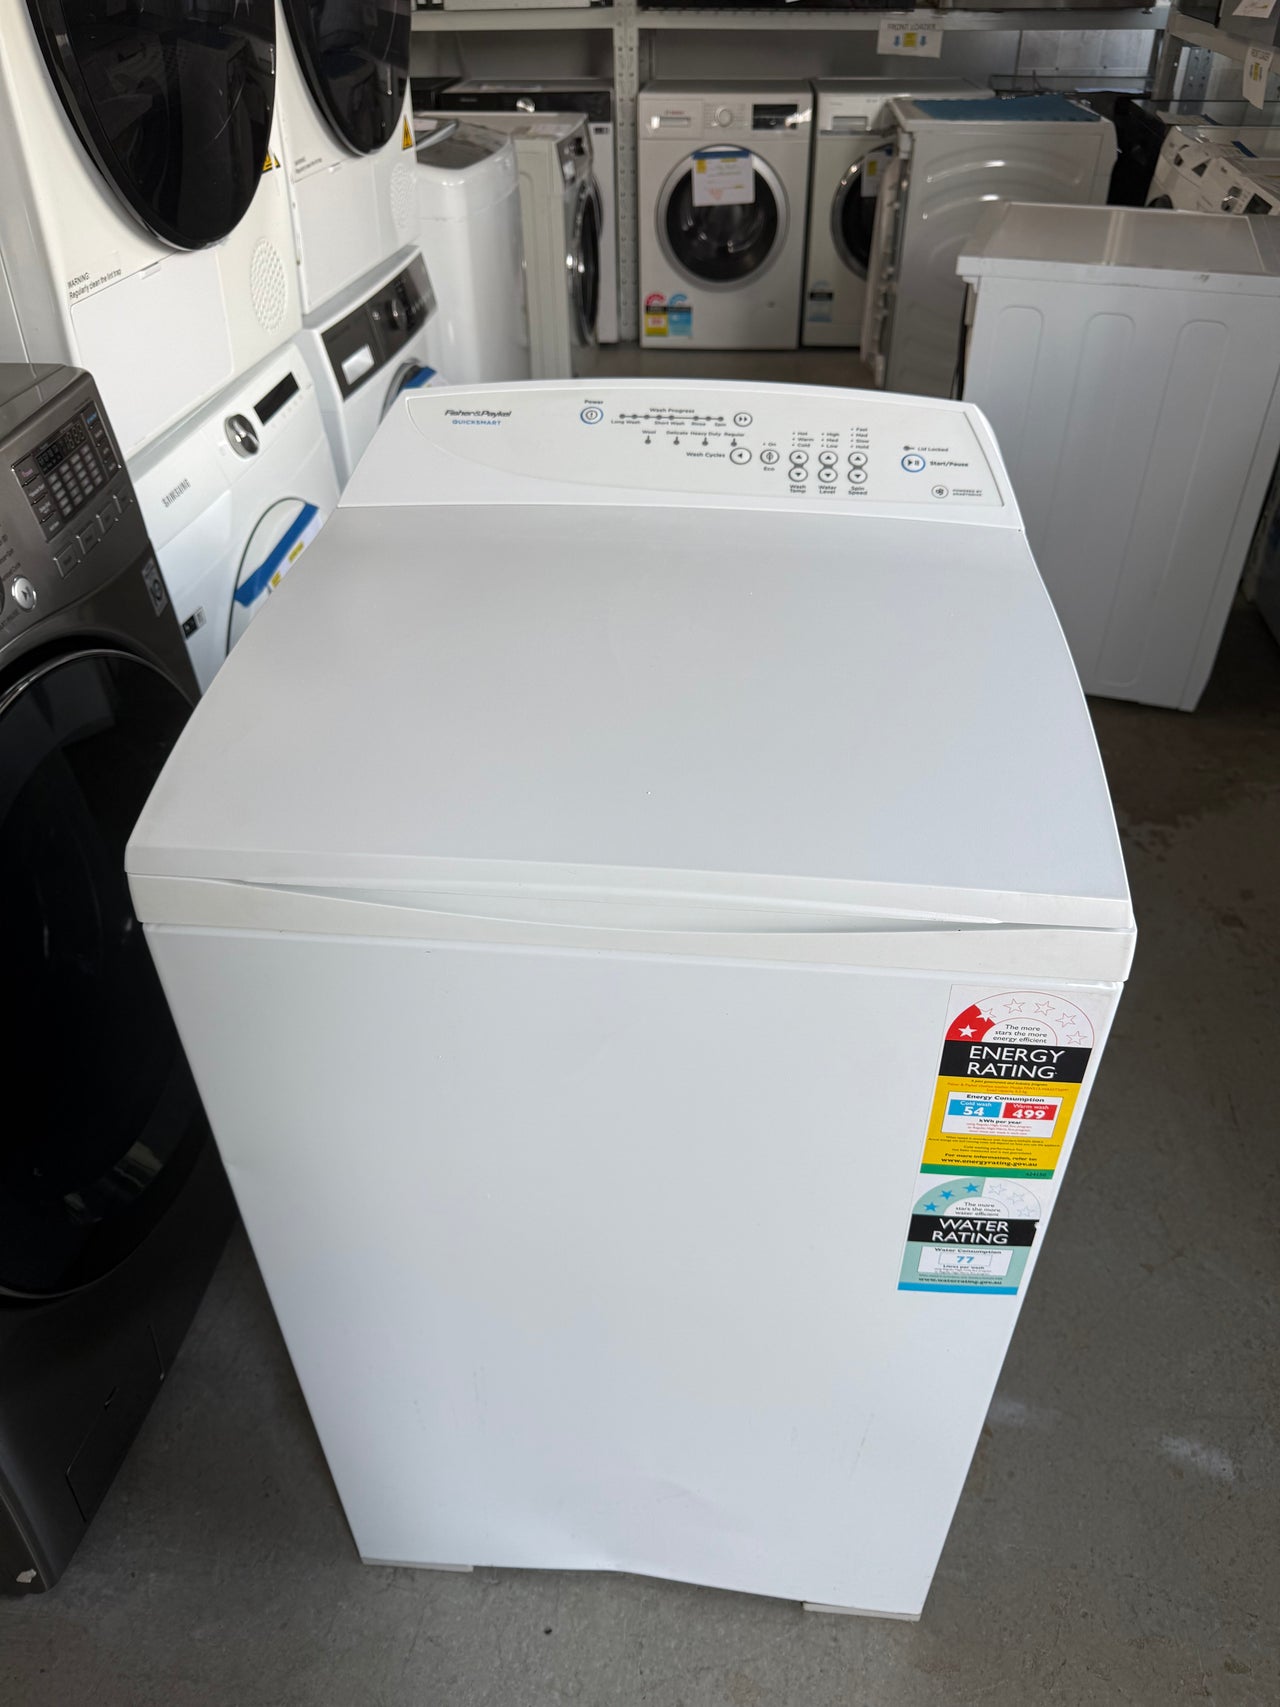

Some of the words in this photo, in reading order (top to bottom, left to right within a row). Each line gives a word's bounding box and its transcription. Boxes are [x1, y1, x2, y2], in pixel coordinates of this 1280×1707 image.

[90, 279, 100, 290] clean
[444, 410, 512, 418] Fisher&Paykel
[969, 1045, 1066, 1063] ENERGY
[967, 1062, 1056, 1079] RATING
[963, 1107, 985, 1116] 54
[1012, 1110, 1046, 1119] 499
[942, 1158, 1037, 1167] www.energyrating.gov.au
[939, 1218, 1009, 1233] WATER
[932, 1231, 1009, 1244] RATING
